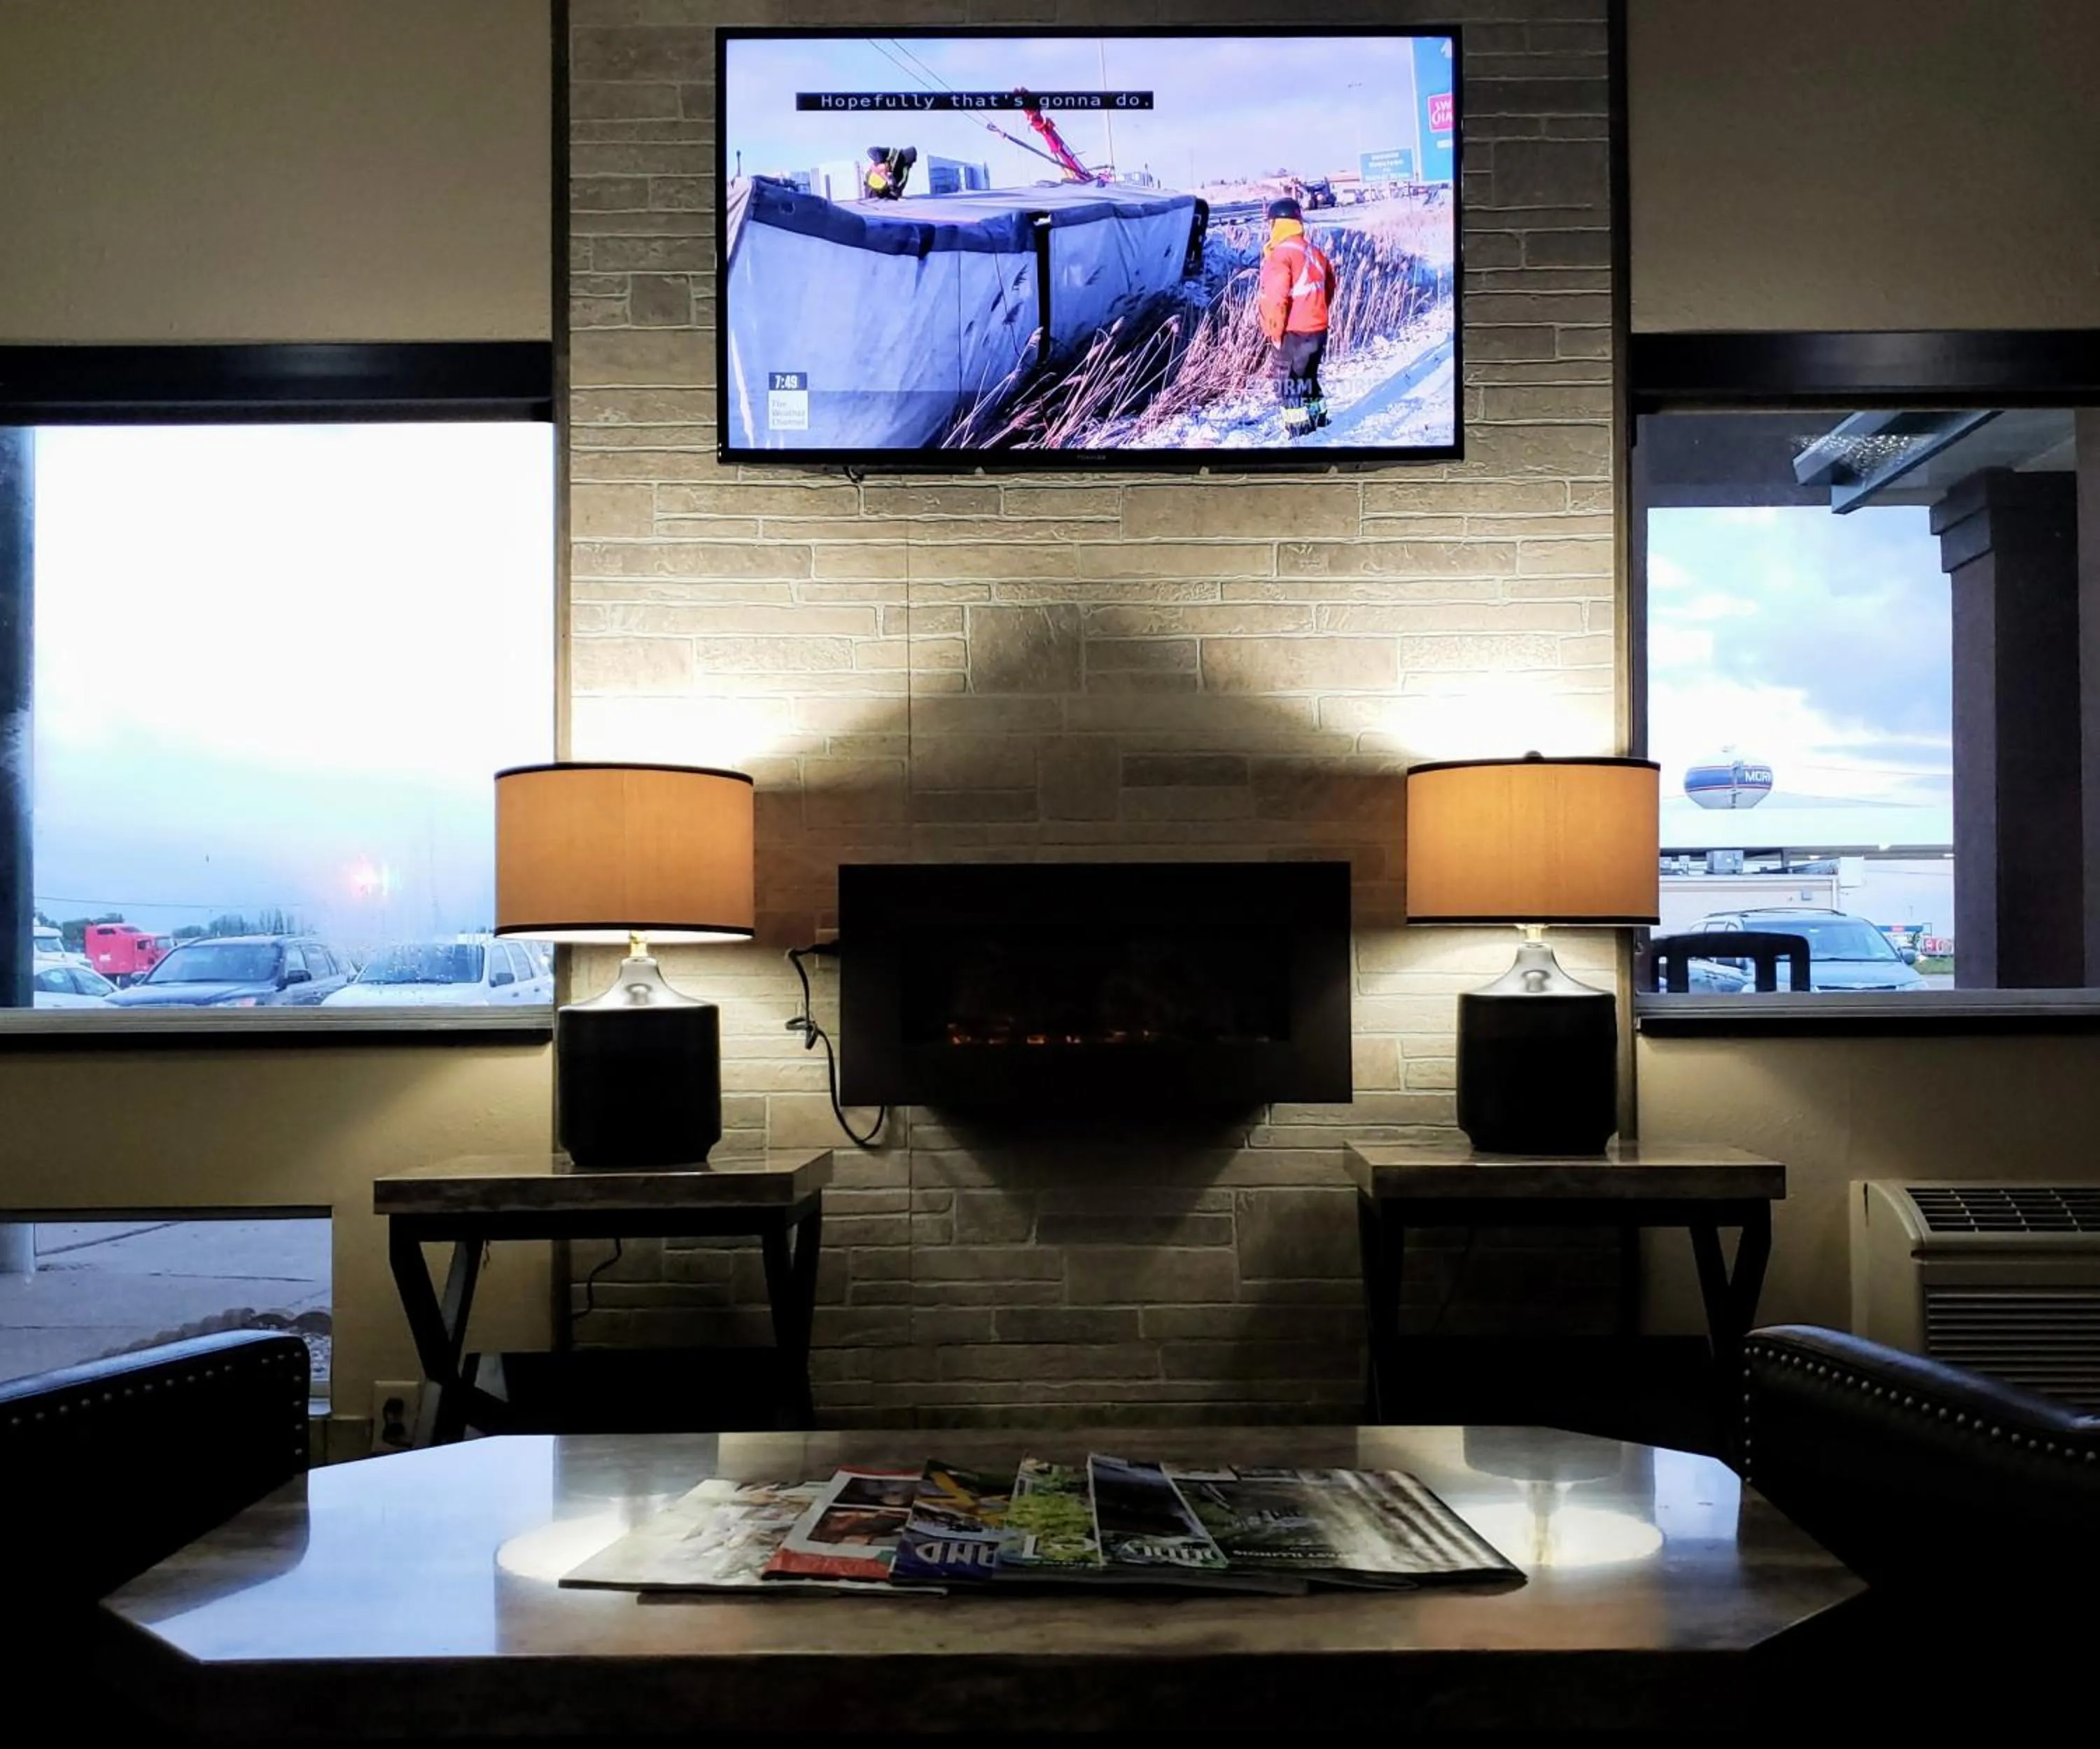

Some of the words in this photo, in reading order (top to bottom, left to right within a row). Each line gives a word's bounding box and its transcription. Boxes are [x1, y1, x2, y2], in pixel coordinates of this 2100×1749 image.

[821, 94, 934, 111] Hopefully
[951, 94, 1024, 107] that's
[1040, 95, 1102, 110] gonna
[1116, 93, 1149, 106] do.
[775, 375, 798, 389] 7:49
